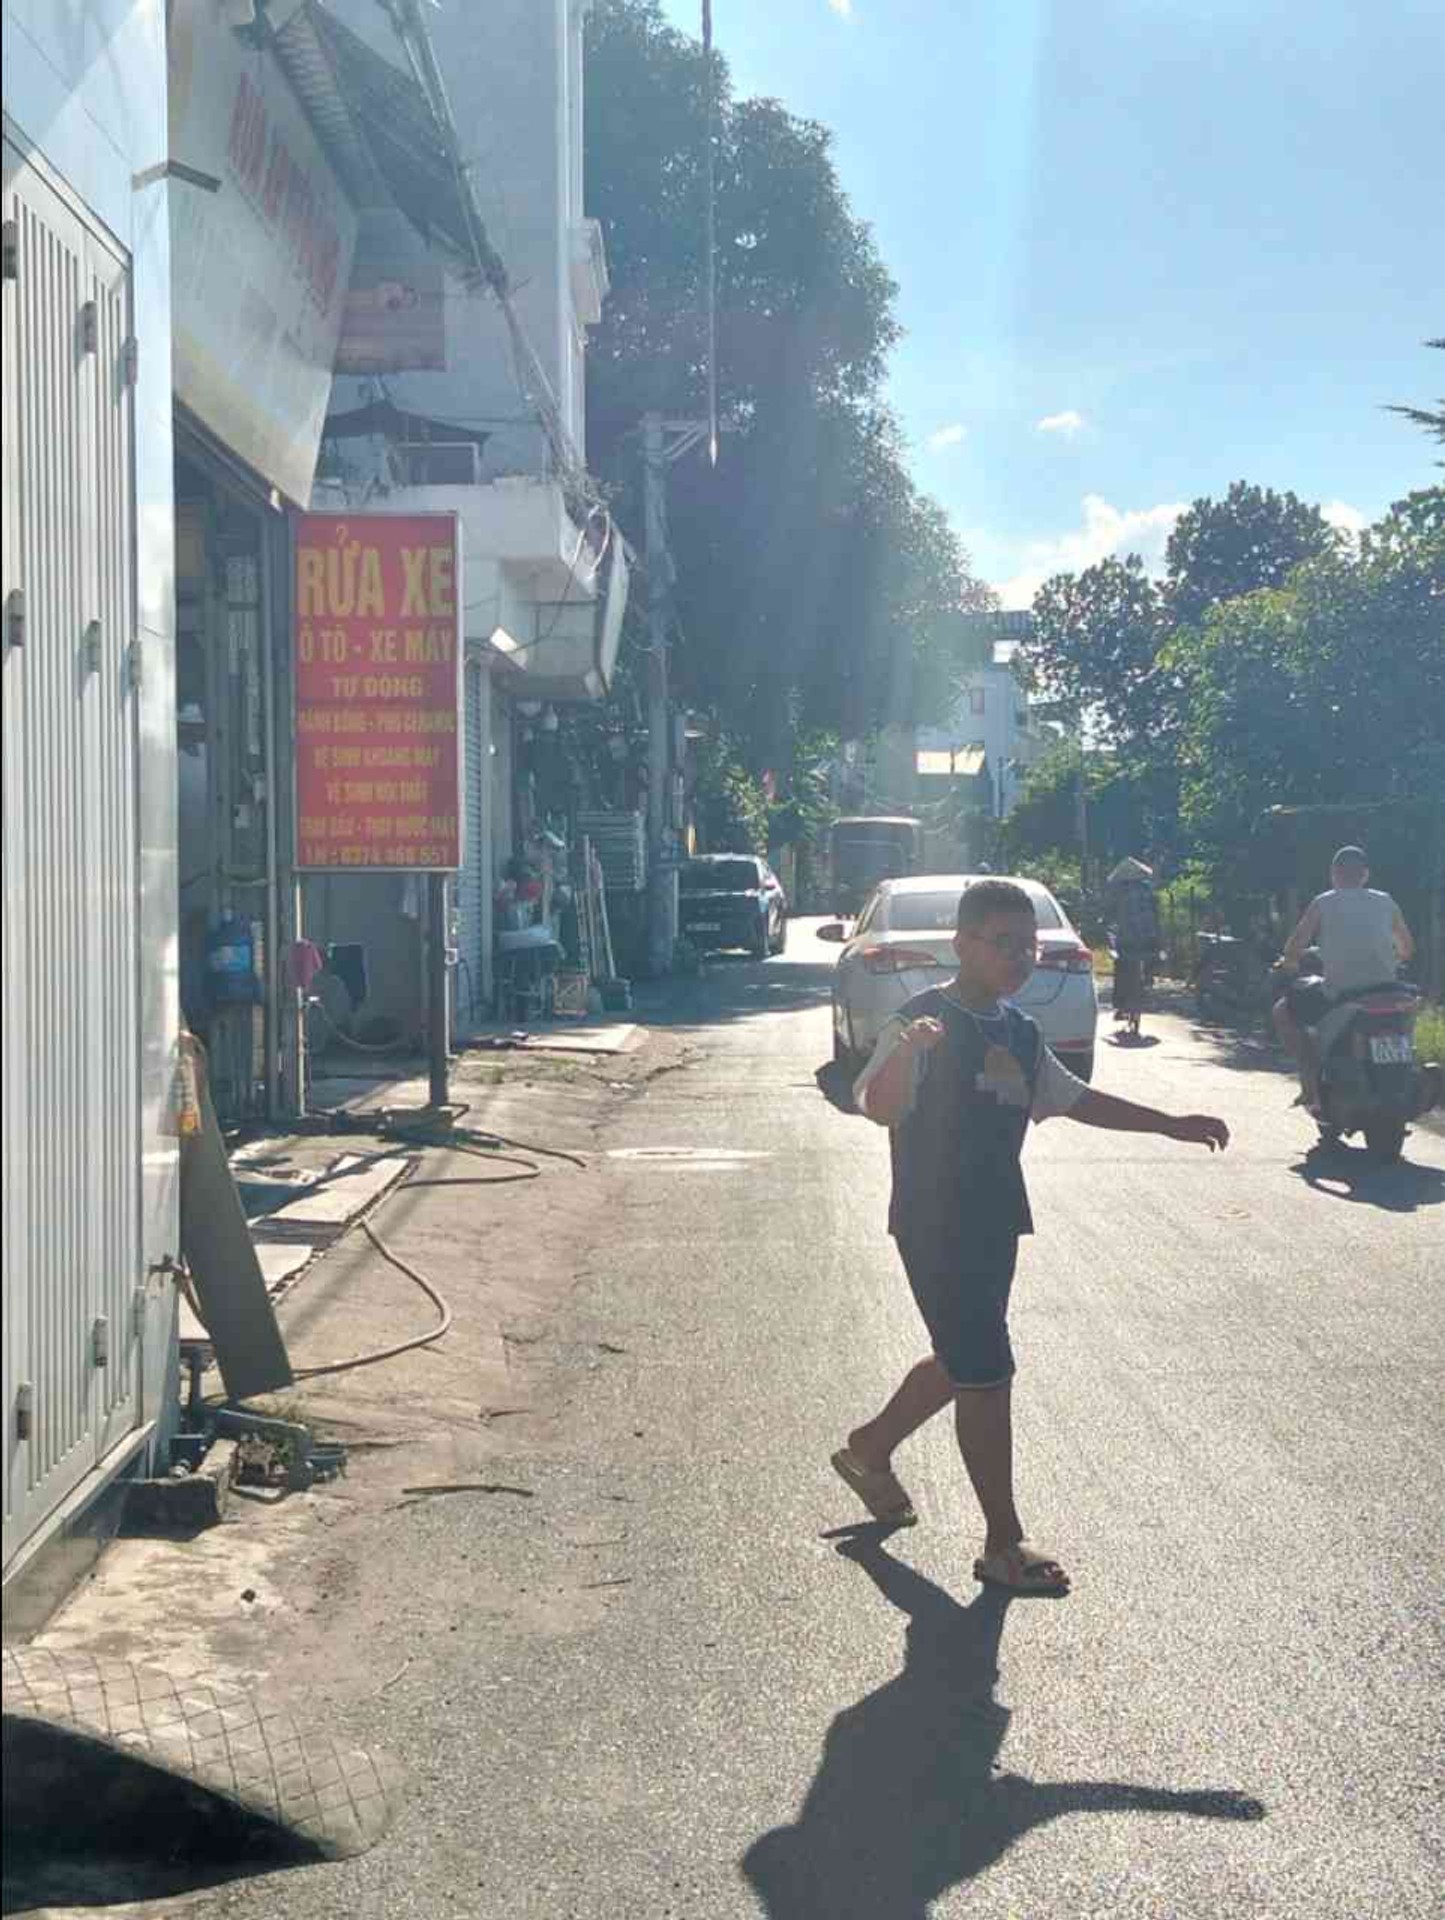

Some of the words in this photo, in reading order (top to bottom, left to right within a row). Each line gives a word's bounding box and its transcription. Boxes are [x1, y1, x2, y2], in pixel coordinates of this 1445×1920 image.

[297, 524, 384, 617] RỬA
[400, 546, 455, 617] XE
[301, 624, 314, 662] Ô
[320, 624, 346, 662] TÔ
[371, 629, 397, 662] XE
